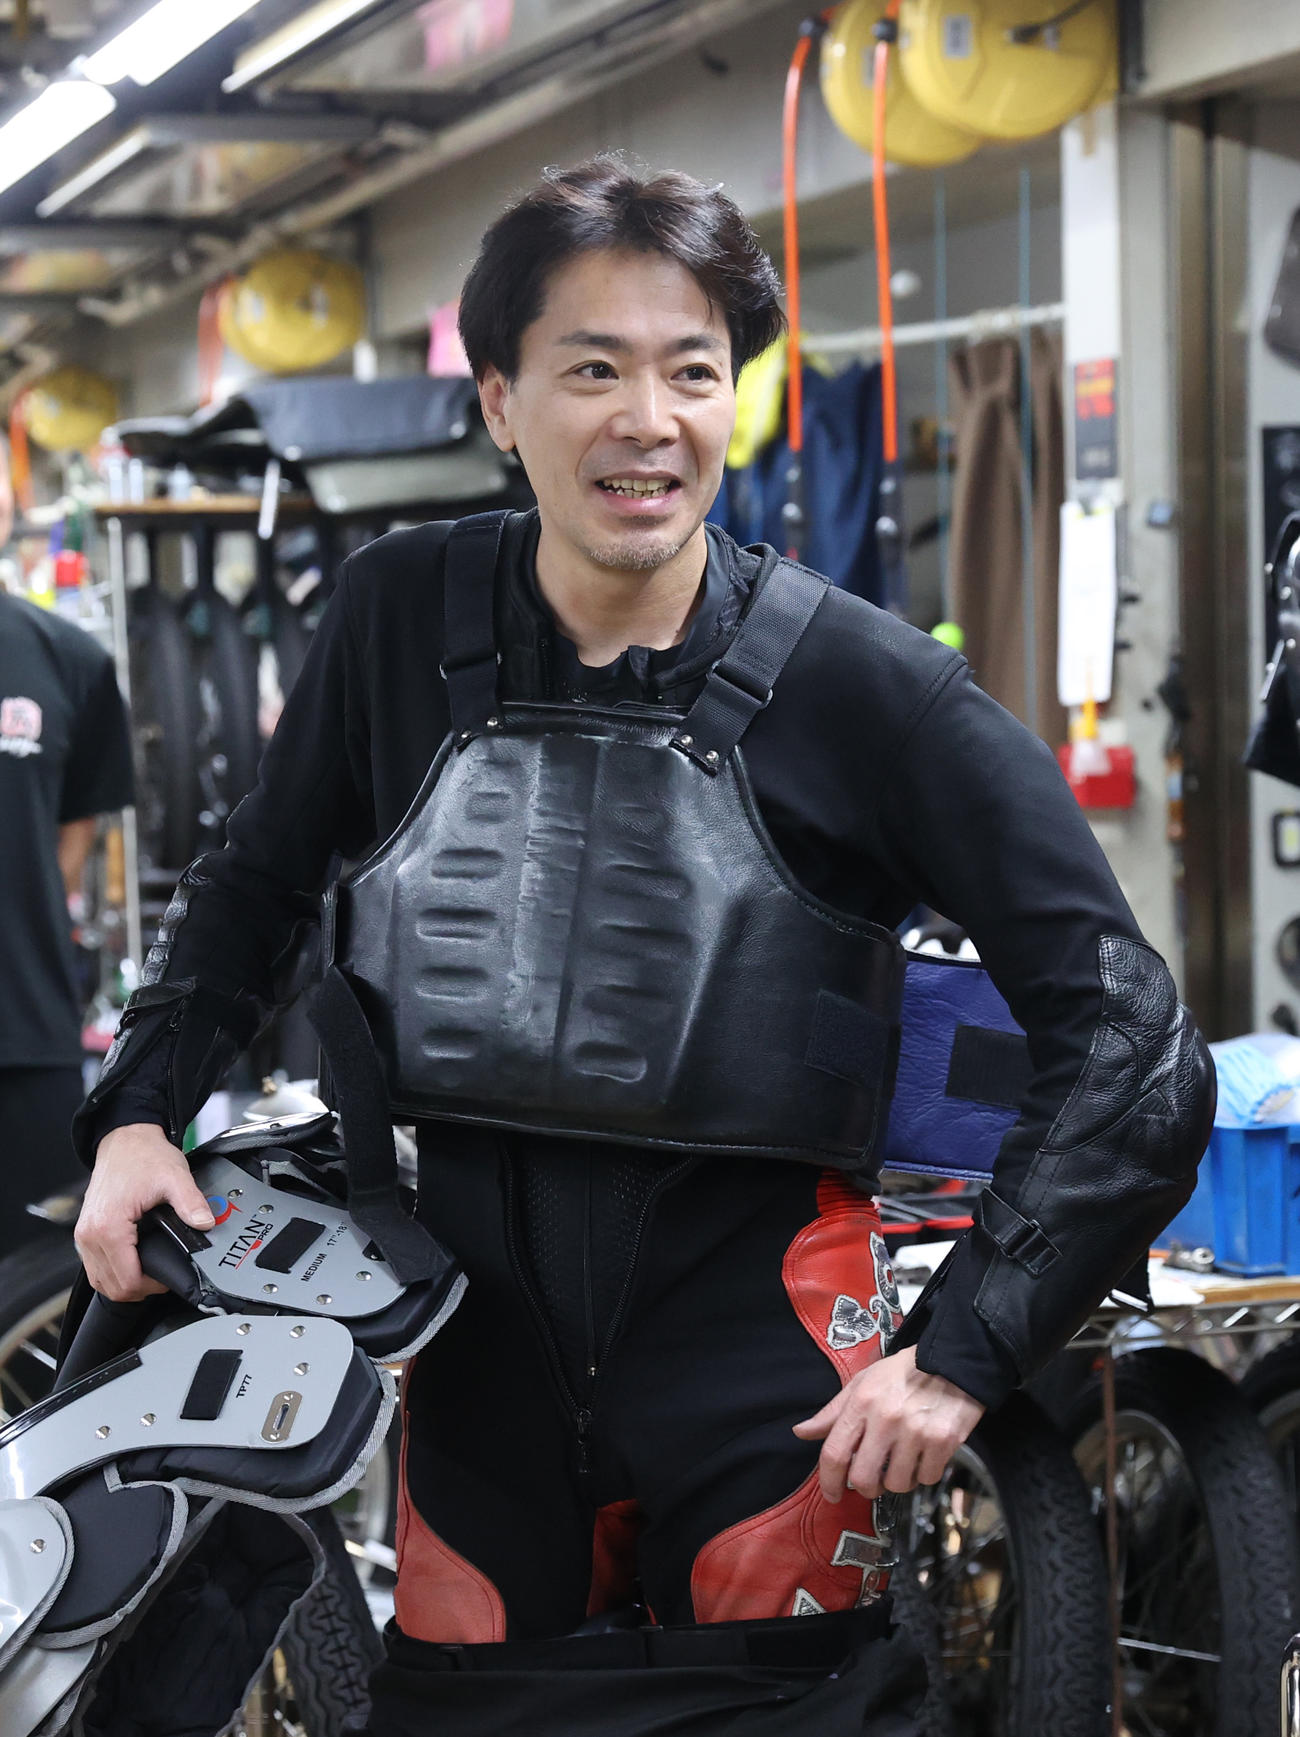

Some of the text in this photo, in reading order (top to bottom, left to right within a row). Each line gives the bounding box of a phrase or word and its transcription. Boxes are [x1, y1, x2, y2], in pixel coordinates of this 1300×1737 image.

[257, 1223, 274, 1242] PRO
[301, 1252, 328, 1282] MEDIUM
[235, 1373, 253, 1399] TP77
